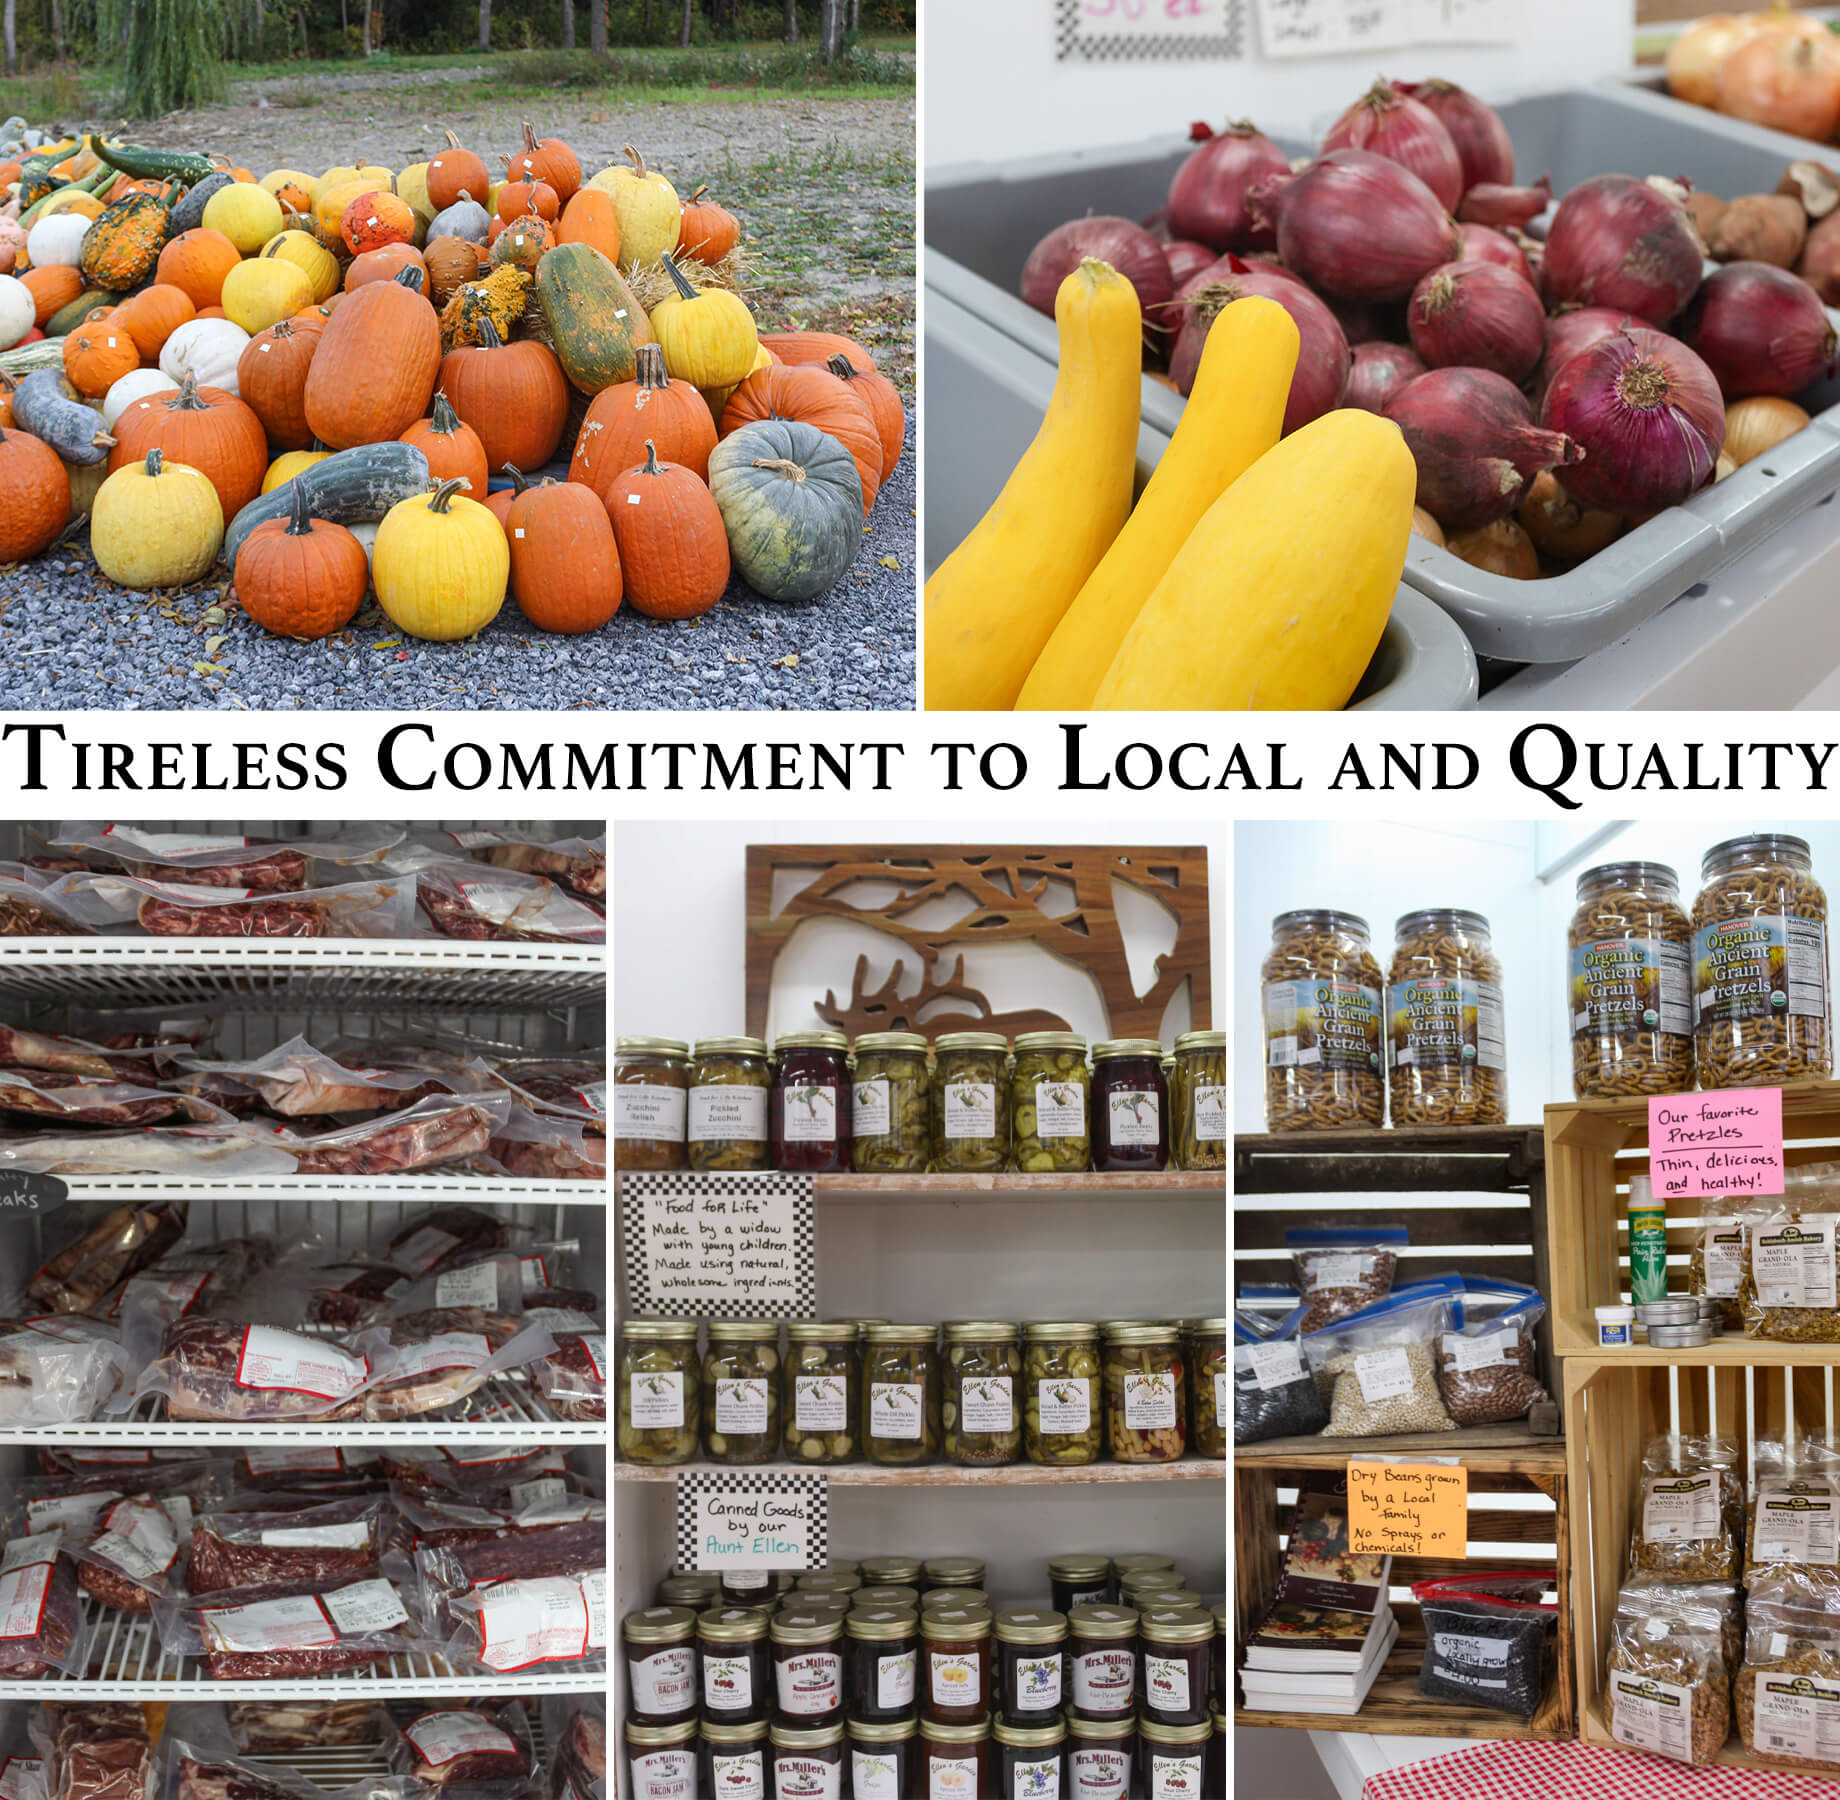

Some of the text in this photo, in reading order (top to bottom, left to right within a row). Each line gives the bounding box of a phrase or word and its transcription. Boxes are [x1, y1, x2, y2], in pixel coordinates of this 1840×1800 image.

[1706, 926, 1770, 950] Organic
[1583, 946, 1644, 968] Organic
[1707, 945, 1770, 968] Ancient
[1584, 964, 1644, 984] Ancient
[1714, 961, 1761, 982] Grain
[1314, 986, 1371, 1010] Organic
[1404, 988, 1463, 1004] Organic
[1590, 980, 1635, 998] Grain
[1710, 978, 1772, 999] Pretzels
[1314, 1004, 1371, 1024] Ancient
[1406, 1003, 1464, 1018] Ancient
[1585, 996, 1645, 1014] Pretzels
[1323, 1019, 1366, 1037] Grain
[1412, 1017, 1456, 1032] Grain
[1316, 1033, 1372, 1054] Pretzels
[1406, 1032, 1464, 1046] Pretzels
[708, 1114, 742, 1122] Zucchini
[1658, 1102, 1759, 1126] Our favorite
[1667, 1125, 1743, 1143] Pretzles
[1656, 1158, 1699, 1172] Thin,
[1666, 1172, 1762, 1191] and healthy!
[652, 1220, 782, 1240] Made by a widow
[664, 1238, 792, 1257] with young children.
[655, 1258, 789, 1275] Made using natural,
[1352, 1468, 1460, 1491] Dry Beans grown
[707, 1498, 804, 1519] Canned Goods
[1361, 1490, 1436, 1511] by a Local
[728, 1519, 787, 1538] by our
[1354, 1526, 1446, 1542] No Sprays or
[706, 1535, 799, 1554] Aunt Ellen
[658, 1684, 679, 1694] BACON
